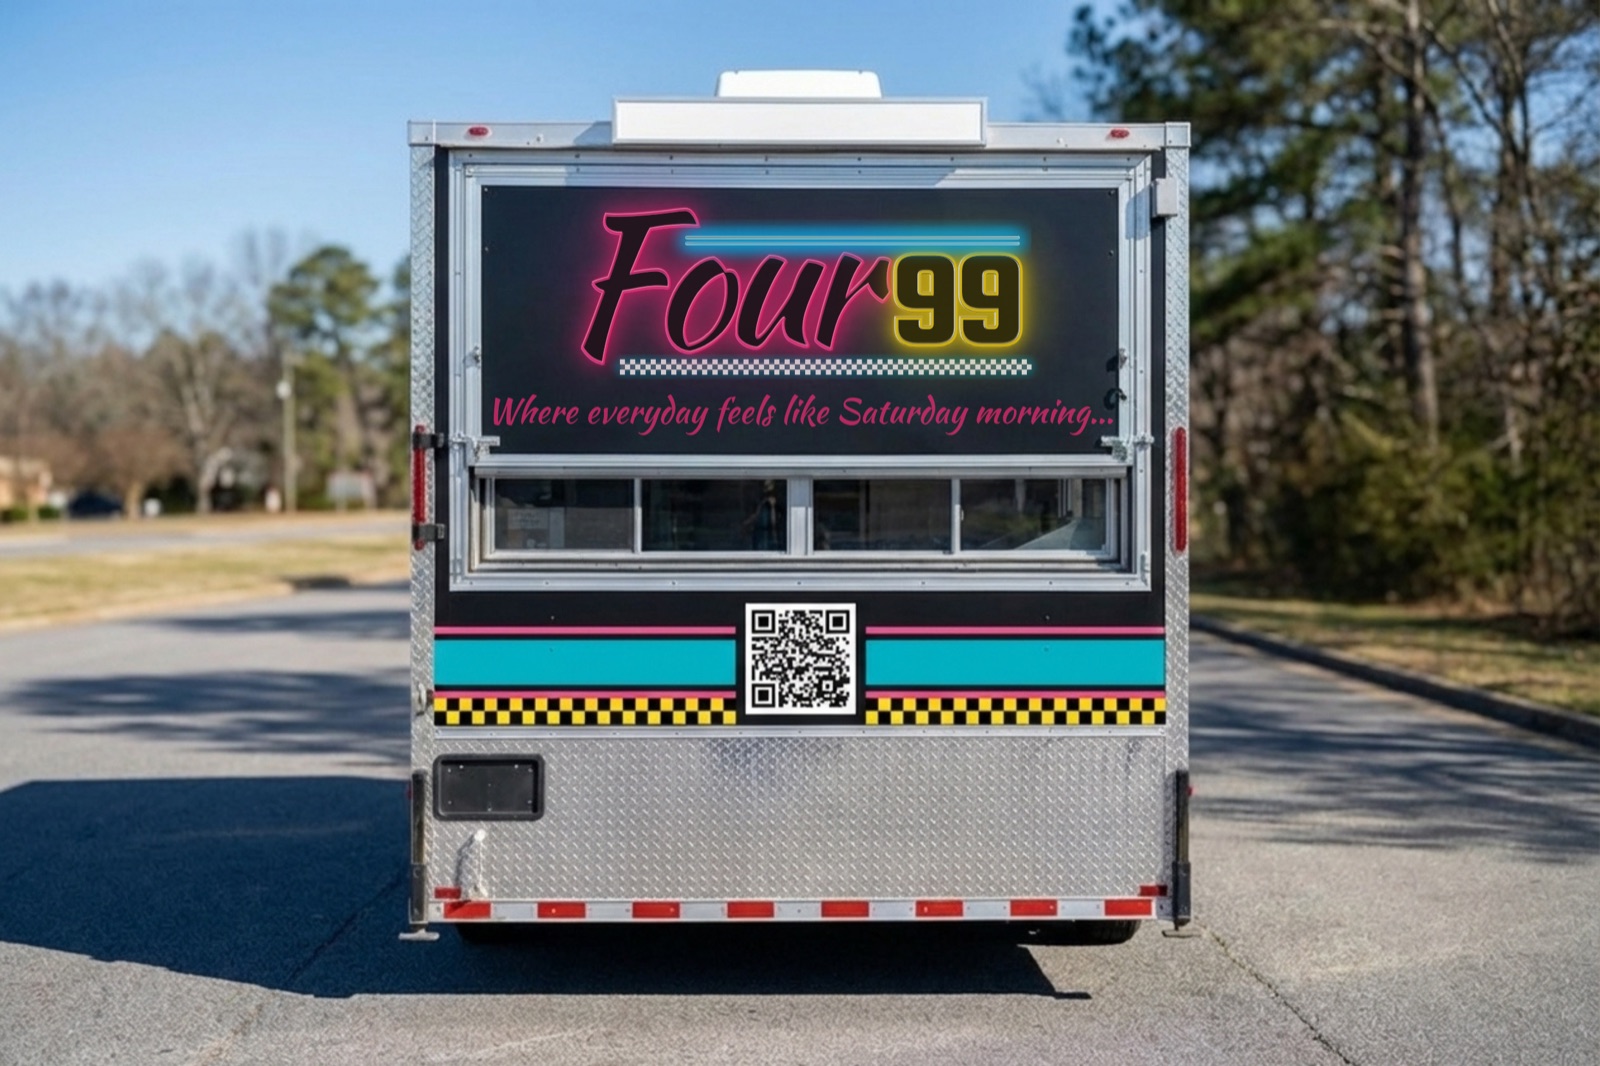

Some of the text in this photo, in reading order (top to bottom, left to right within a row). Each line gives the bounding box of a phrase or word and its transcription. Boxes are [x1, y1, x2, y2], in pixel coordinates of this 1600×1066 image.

[493, 395, 1114, 436] Where everyday feels like Saturday morning...
